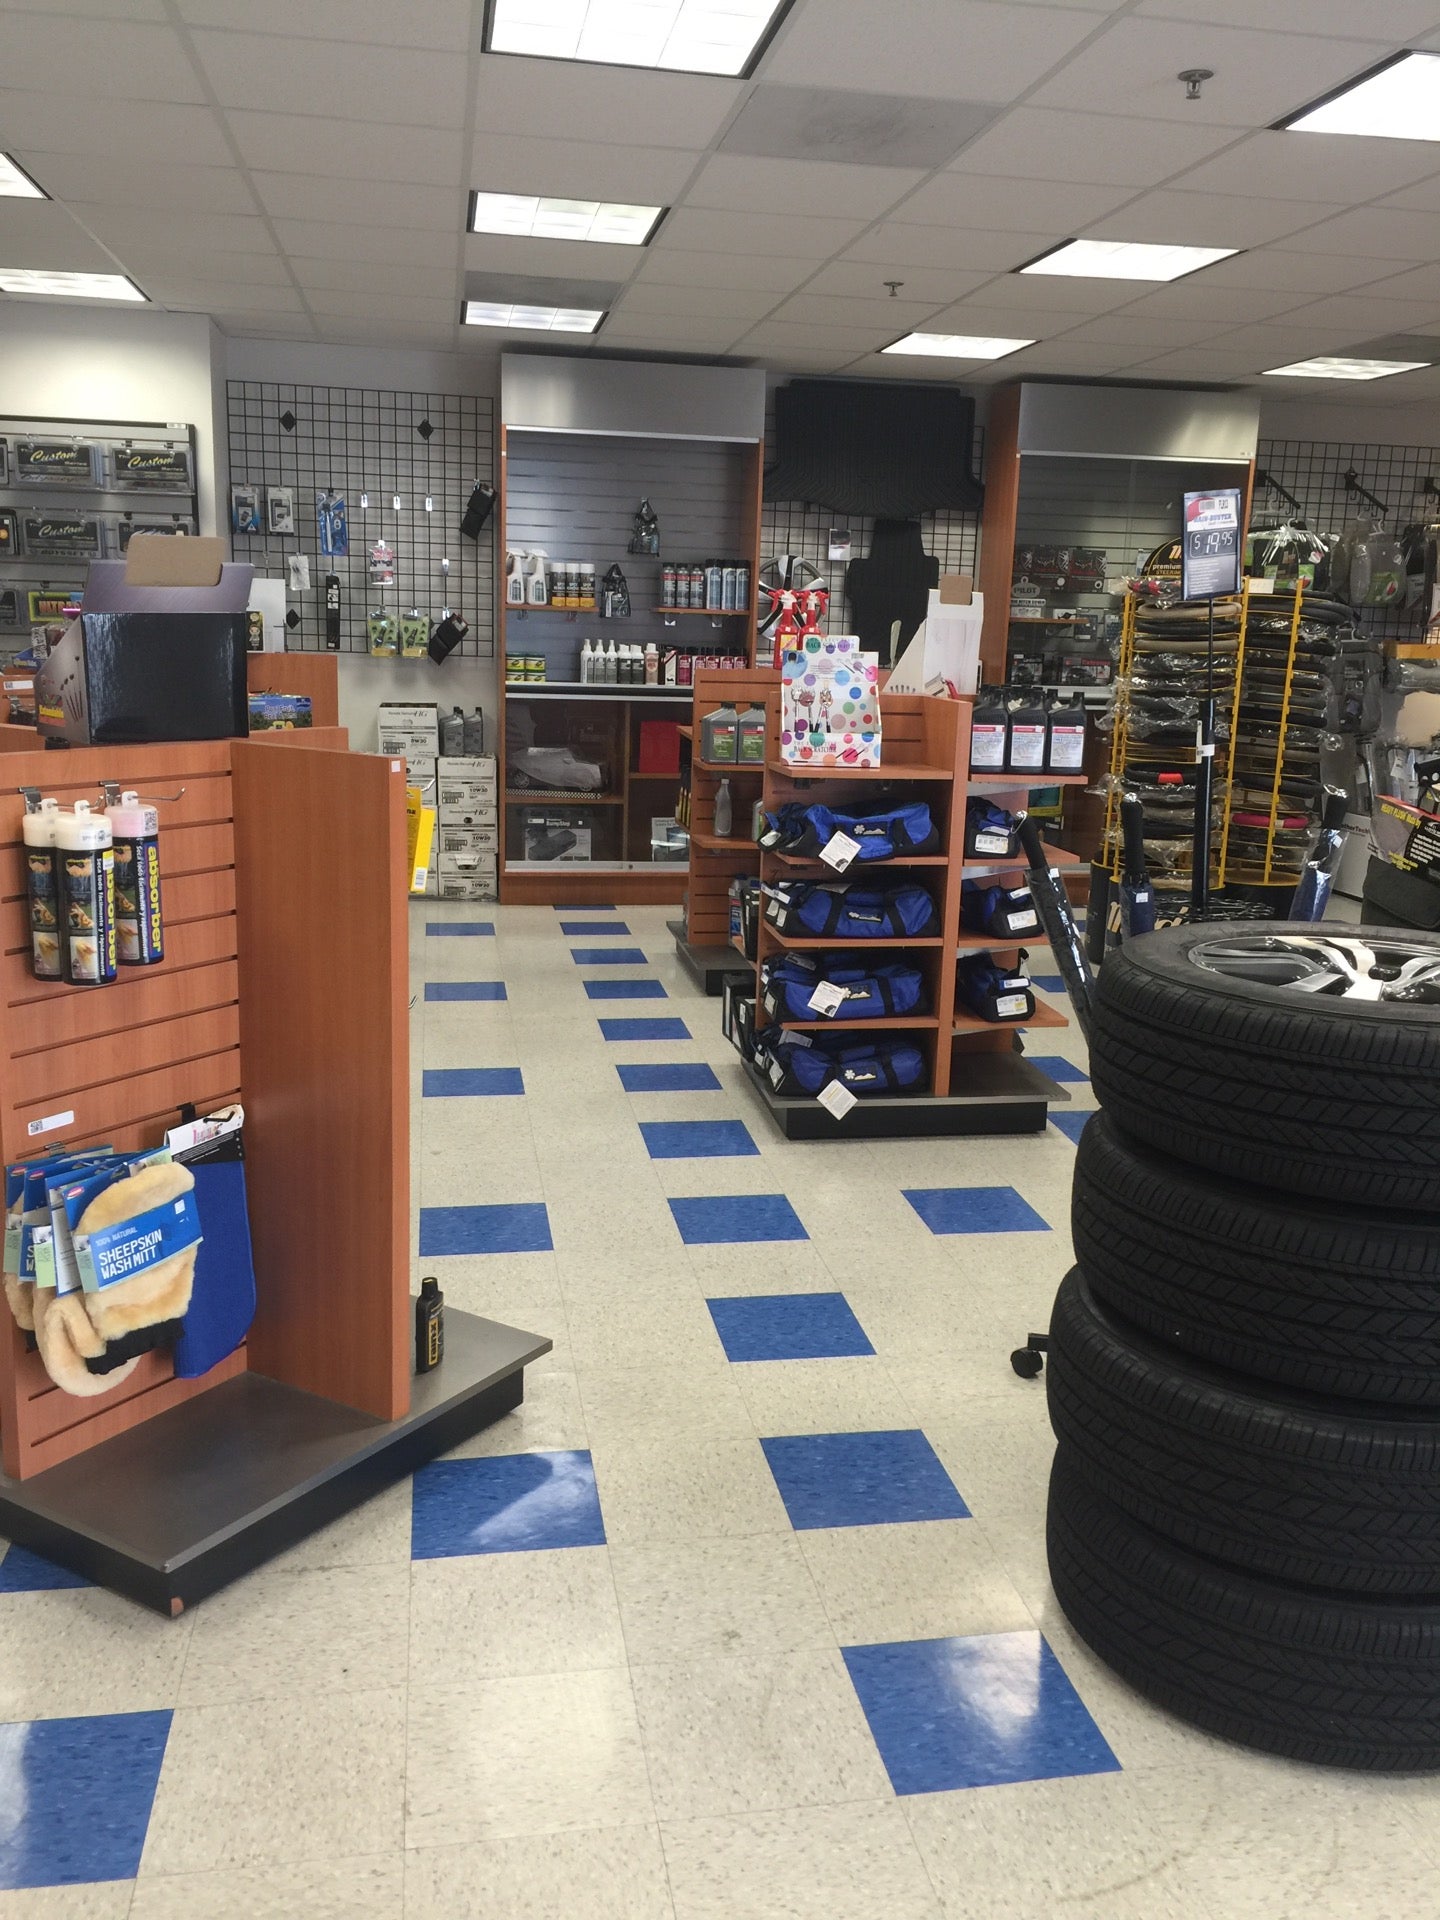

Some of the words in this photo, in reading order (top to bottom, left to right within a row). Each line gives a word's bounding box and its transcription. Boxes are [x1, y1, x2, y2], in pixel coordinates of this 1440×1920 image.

[30, 449, 78, 464] Custom
[127, 455, 174, 471] Custom
[38, 524, 85, 538] Custom
[1013, 586, 1037, 595] PILOT
[148, 846, 161, 952] absorber
[106, 868, 116, 970] bsorber
[112, 1226, 138, 1241] NATURAL
[98, 1229, 162, 1266] SHEEPSKIN
[101, 1257, 132, 1279] WASH
[132, 1245, 156, 1267] MITT
